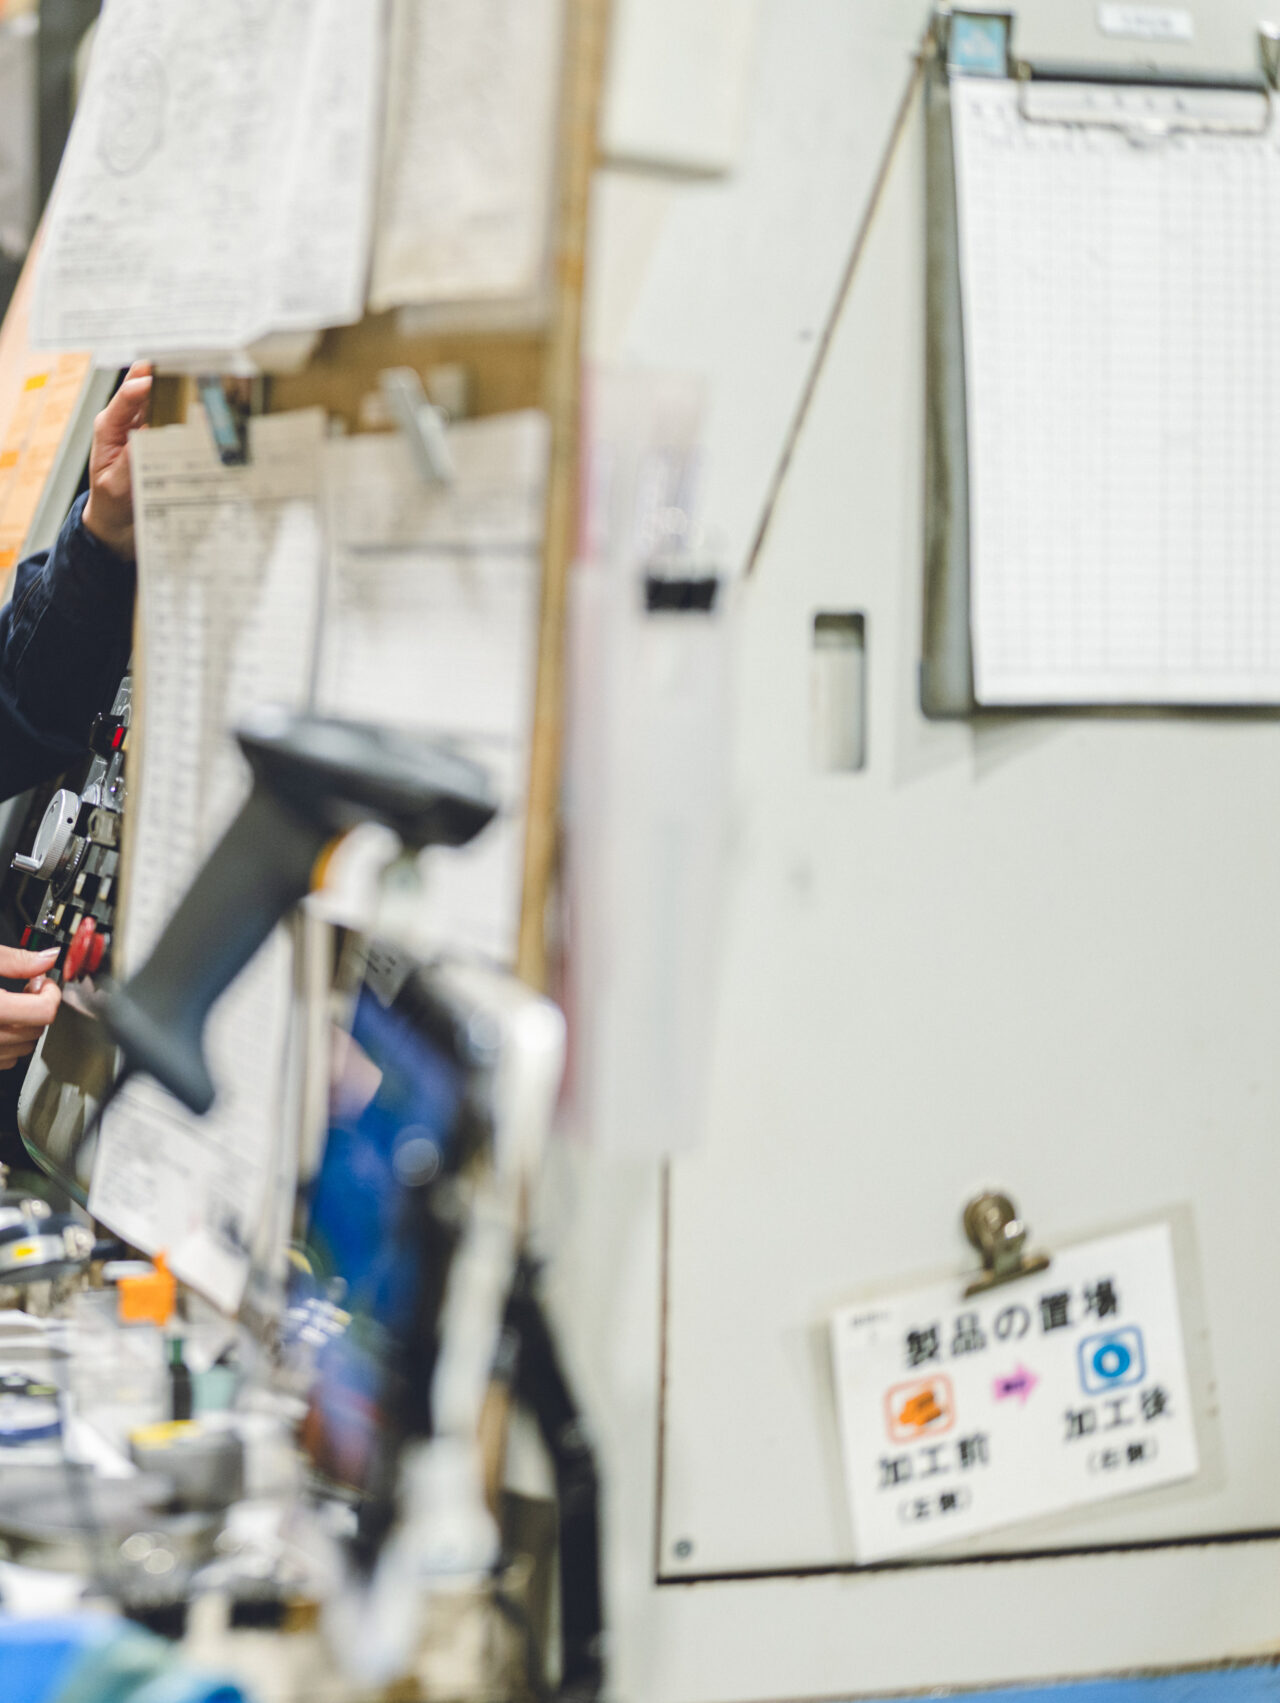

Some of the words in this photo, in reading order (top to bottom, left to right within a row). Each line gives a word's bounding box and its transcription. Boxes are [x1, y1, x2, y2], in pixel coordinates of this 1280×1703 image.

[905, 1278, 1120, 1368] 製品の置場
[1062, 1384, 1172, 1443] 加工後
